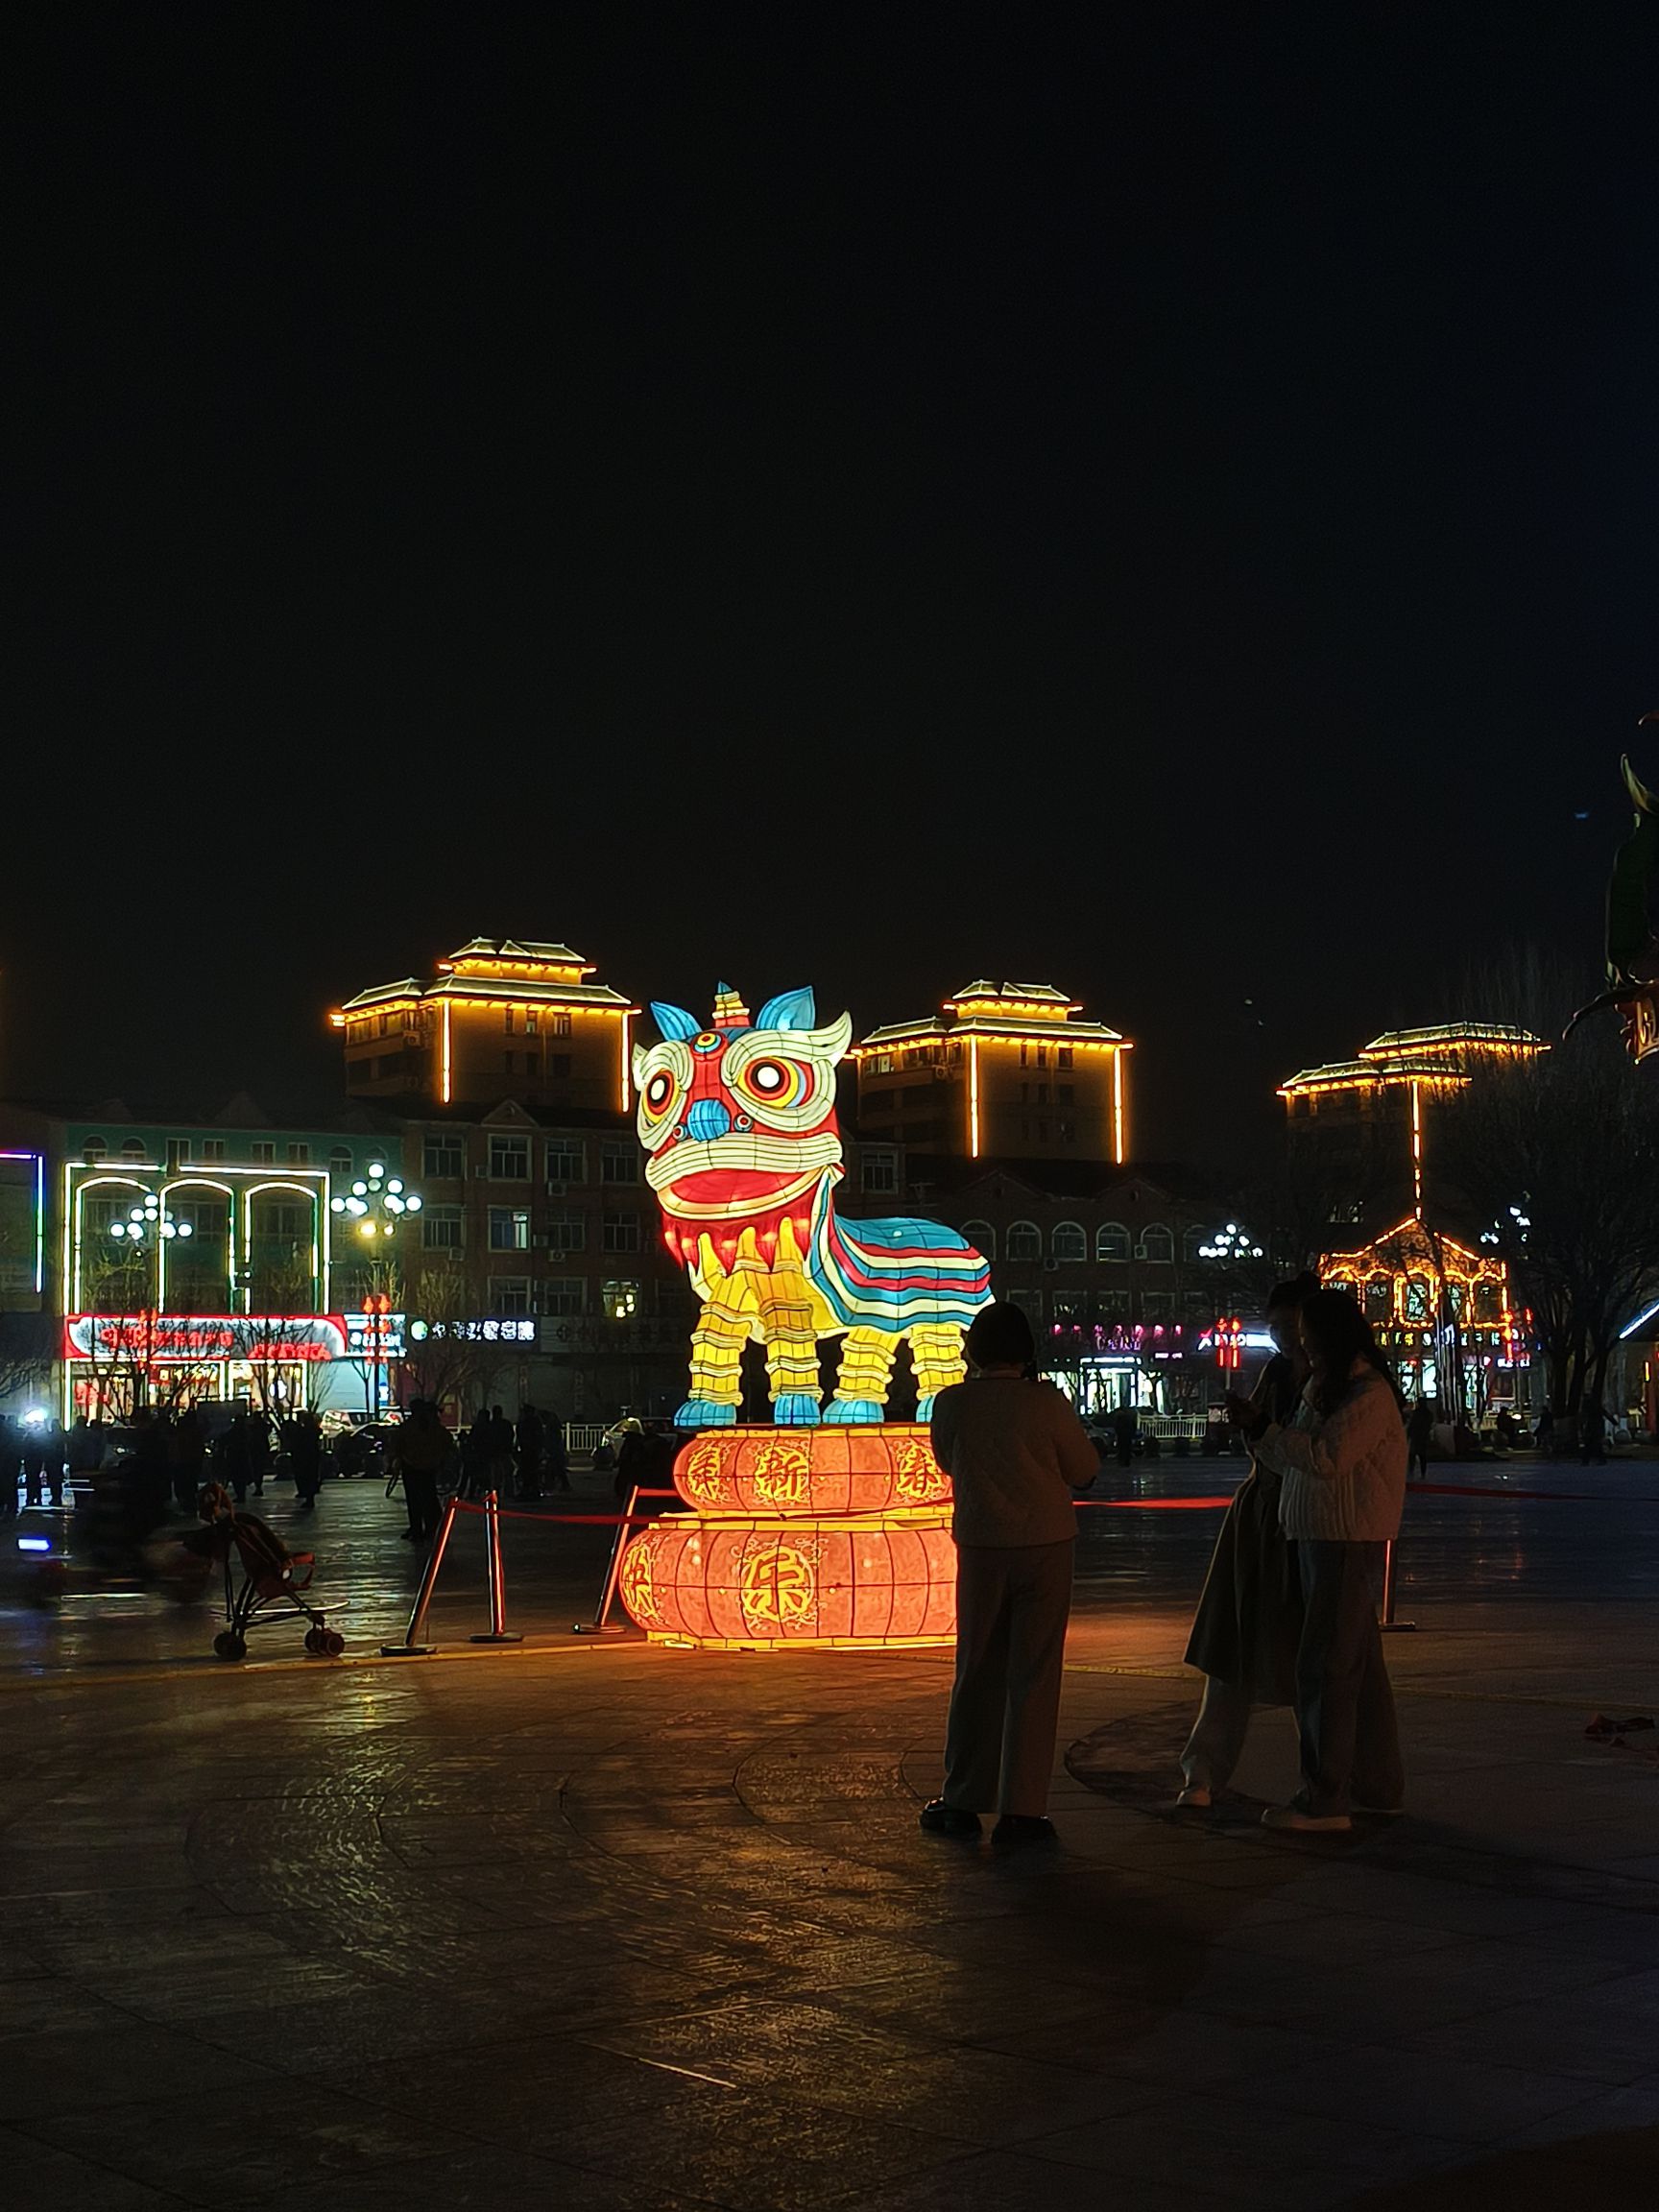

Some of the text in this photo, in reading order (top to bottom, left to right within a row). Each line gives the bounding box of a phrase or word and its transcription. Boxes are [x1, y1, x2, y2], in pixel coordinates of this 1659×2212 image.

[757, 1447, 808, 1500] 新
[899, 1447, 940, 1498] 春
[745, 1548, 807, 1619] 乐
